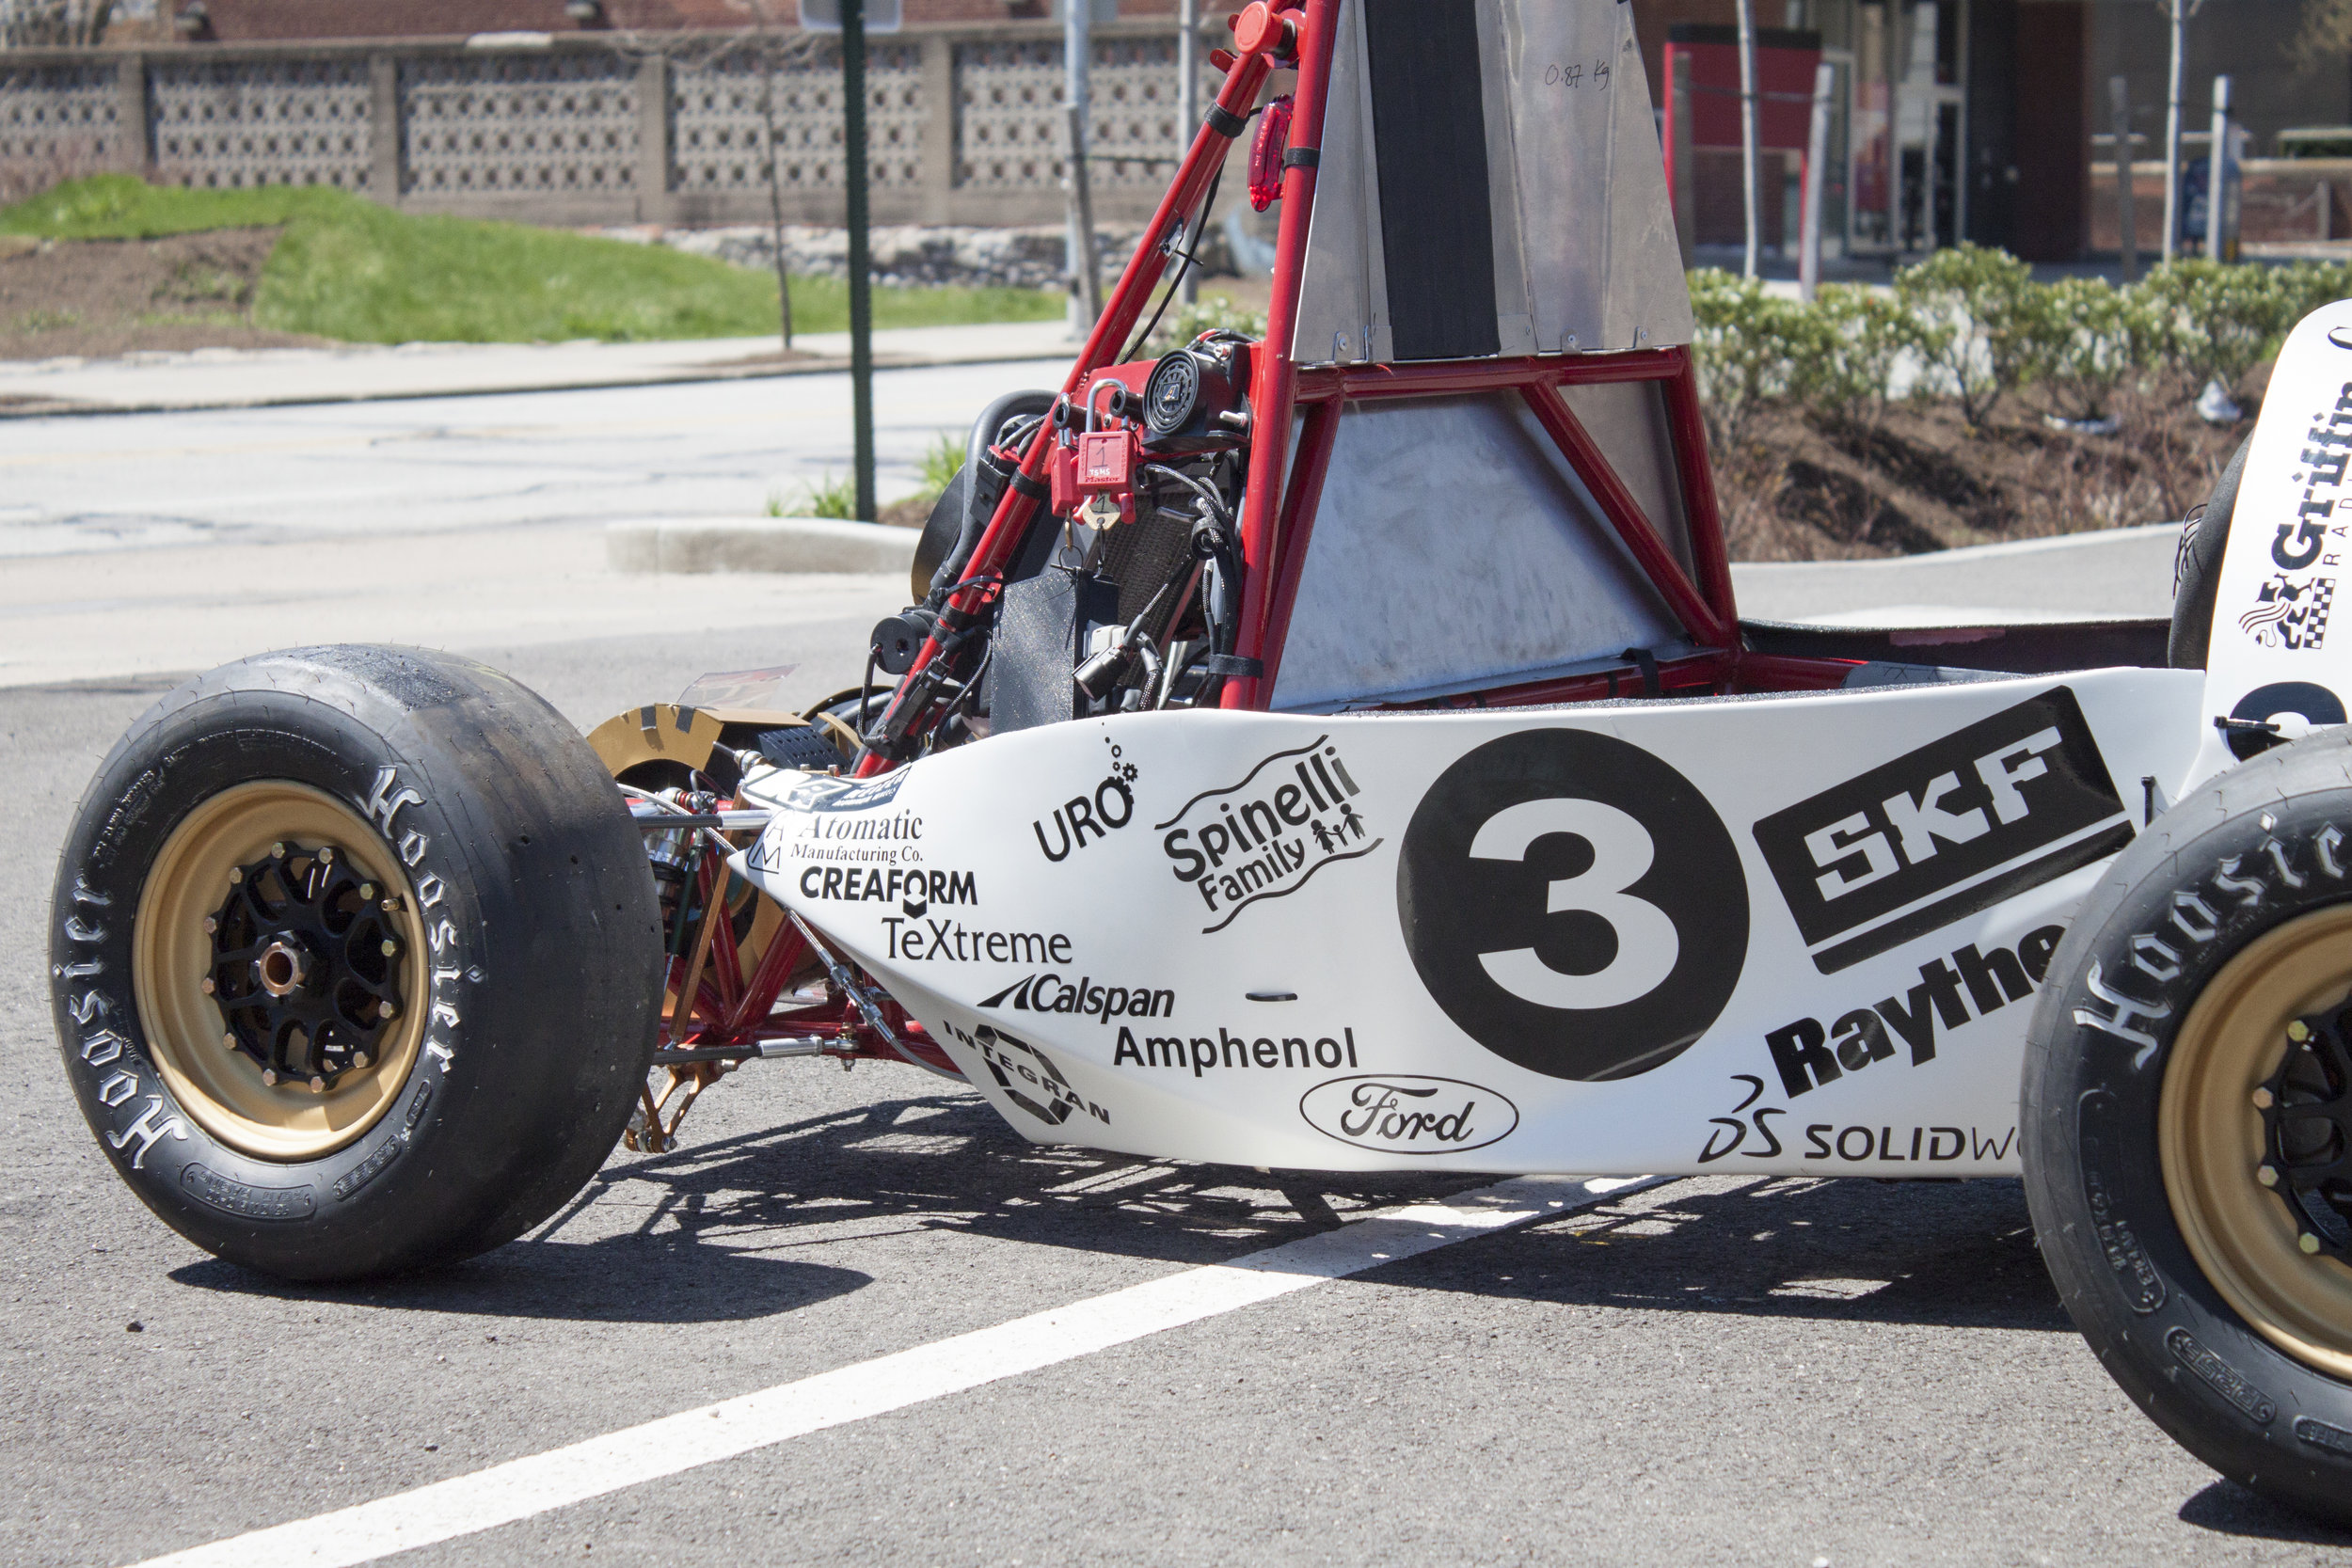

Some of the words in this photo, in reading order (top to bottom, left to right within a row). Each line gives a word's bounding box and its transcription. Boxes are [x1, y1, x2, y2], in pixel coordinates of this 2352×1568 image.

[1545, 64, 1583, 88] 0.87
[1092, 446, 1108, 467] 1
[1091, 495, 1110, 514] 1
[2322, 478, 2352, 566] RAD
[798, 808, 923, 840] Atomatic
[1034, 774, 1135, 863] URO
[1164, 747, 1361, 883] Spinelli
[1804, 725, 2063, 902] SKF
[790, 843, 898, 865] Manufacturing
[901, 846, 924, 862] Co.
[1197, 835, 1304, 911] Family
[800, 867, 977, 906] CREAFORM
[1469, 797, 1679, 1009] 3
[357, 766, 460, 1074] Hoosier
[882, 917, 1073, 964] TeXtreme
[53, 874, 188, 1169] Hoosier
[1032, 974, 1175, 1025] Calspan
[943, 1020, 1111, 1127] INTEGRAN
[1113, 1026, 1359, 1078] Amphenol
[1340, 1082, 1474, 1144] Ford
[1804, 1124, 2022, 1162] SOLIDW
